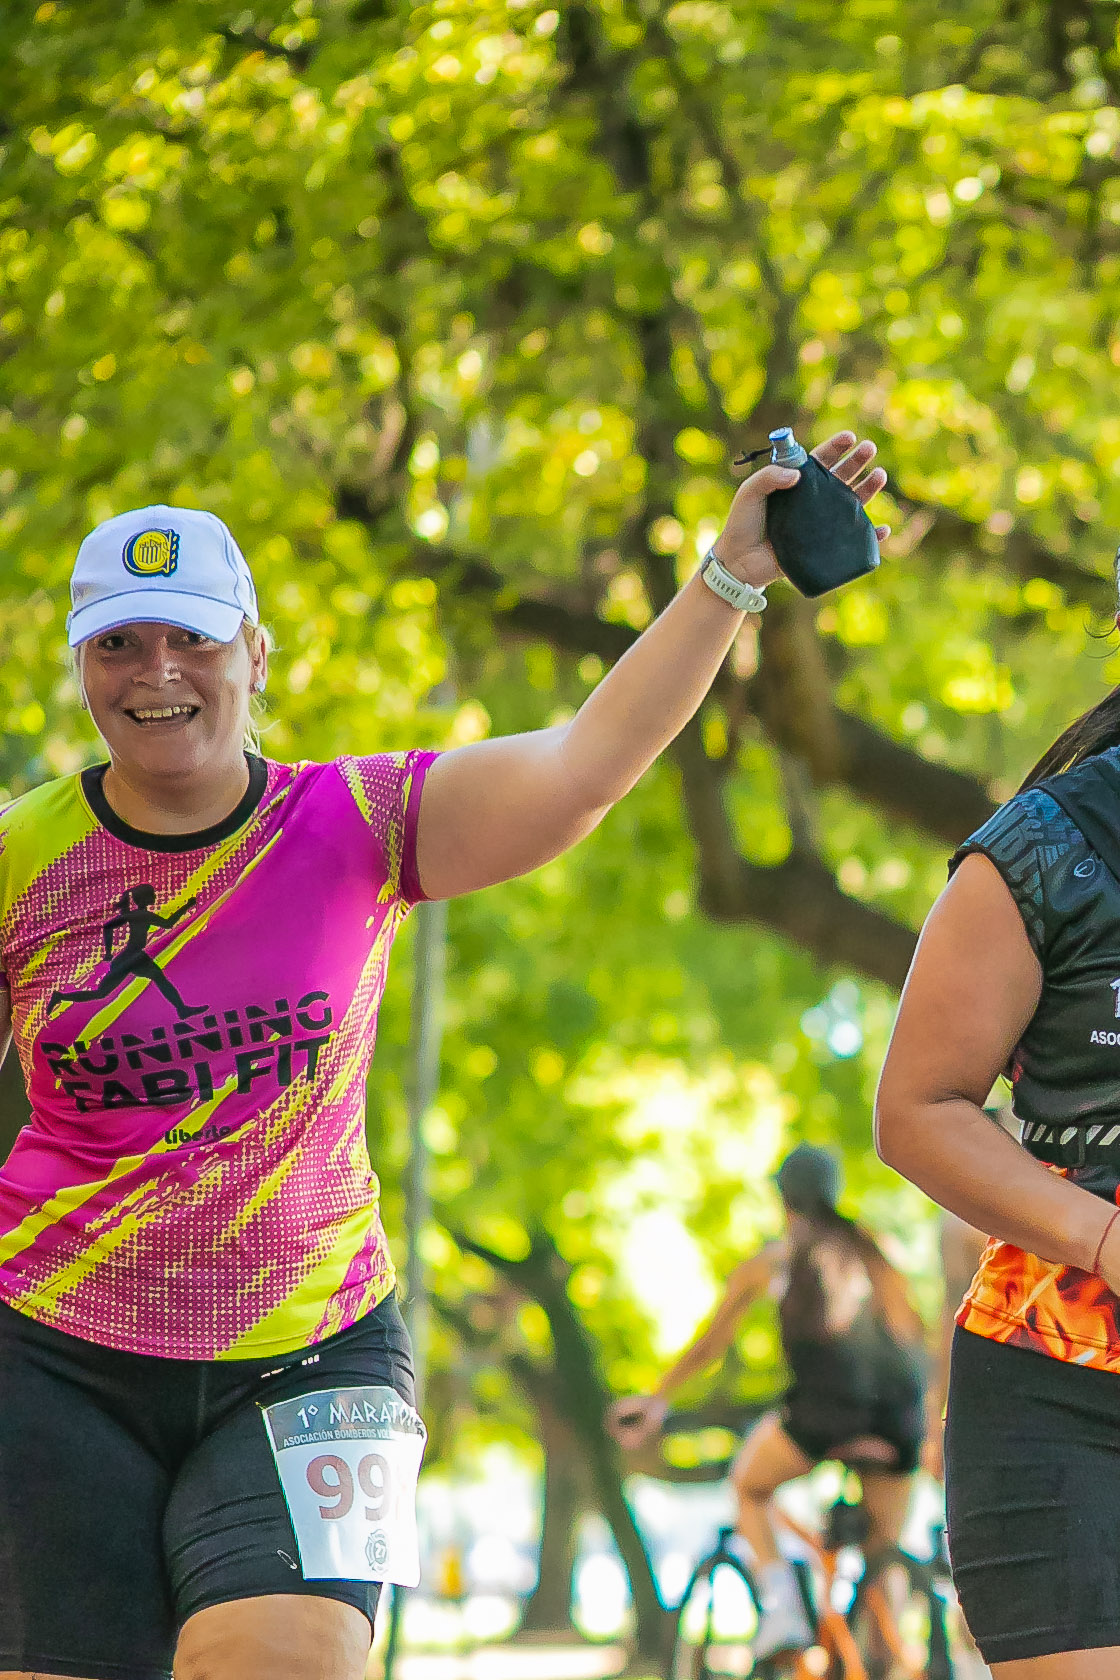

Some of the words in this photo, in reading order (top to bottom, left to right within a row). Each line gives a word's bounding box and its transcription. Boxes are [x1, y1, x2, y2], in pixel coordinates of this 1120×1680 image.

[39, 990, 333, 1079] RUNNING
[236, 1034, 332, 1095] FIT
[283, 1429, 333, 1448] ASOCIACIÓN
[333, 1428, 377, 1440] BOMBEROS
[306, 1454, 392, 1522] 99
